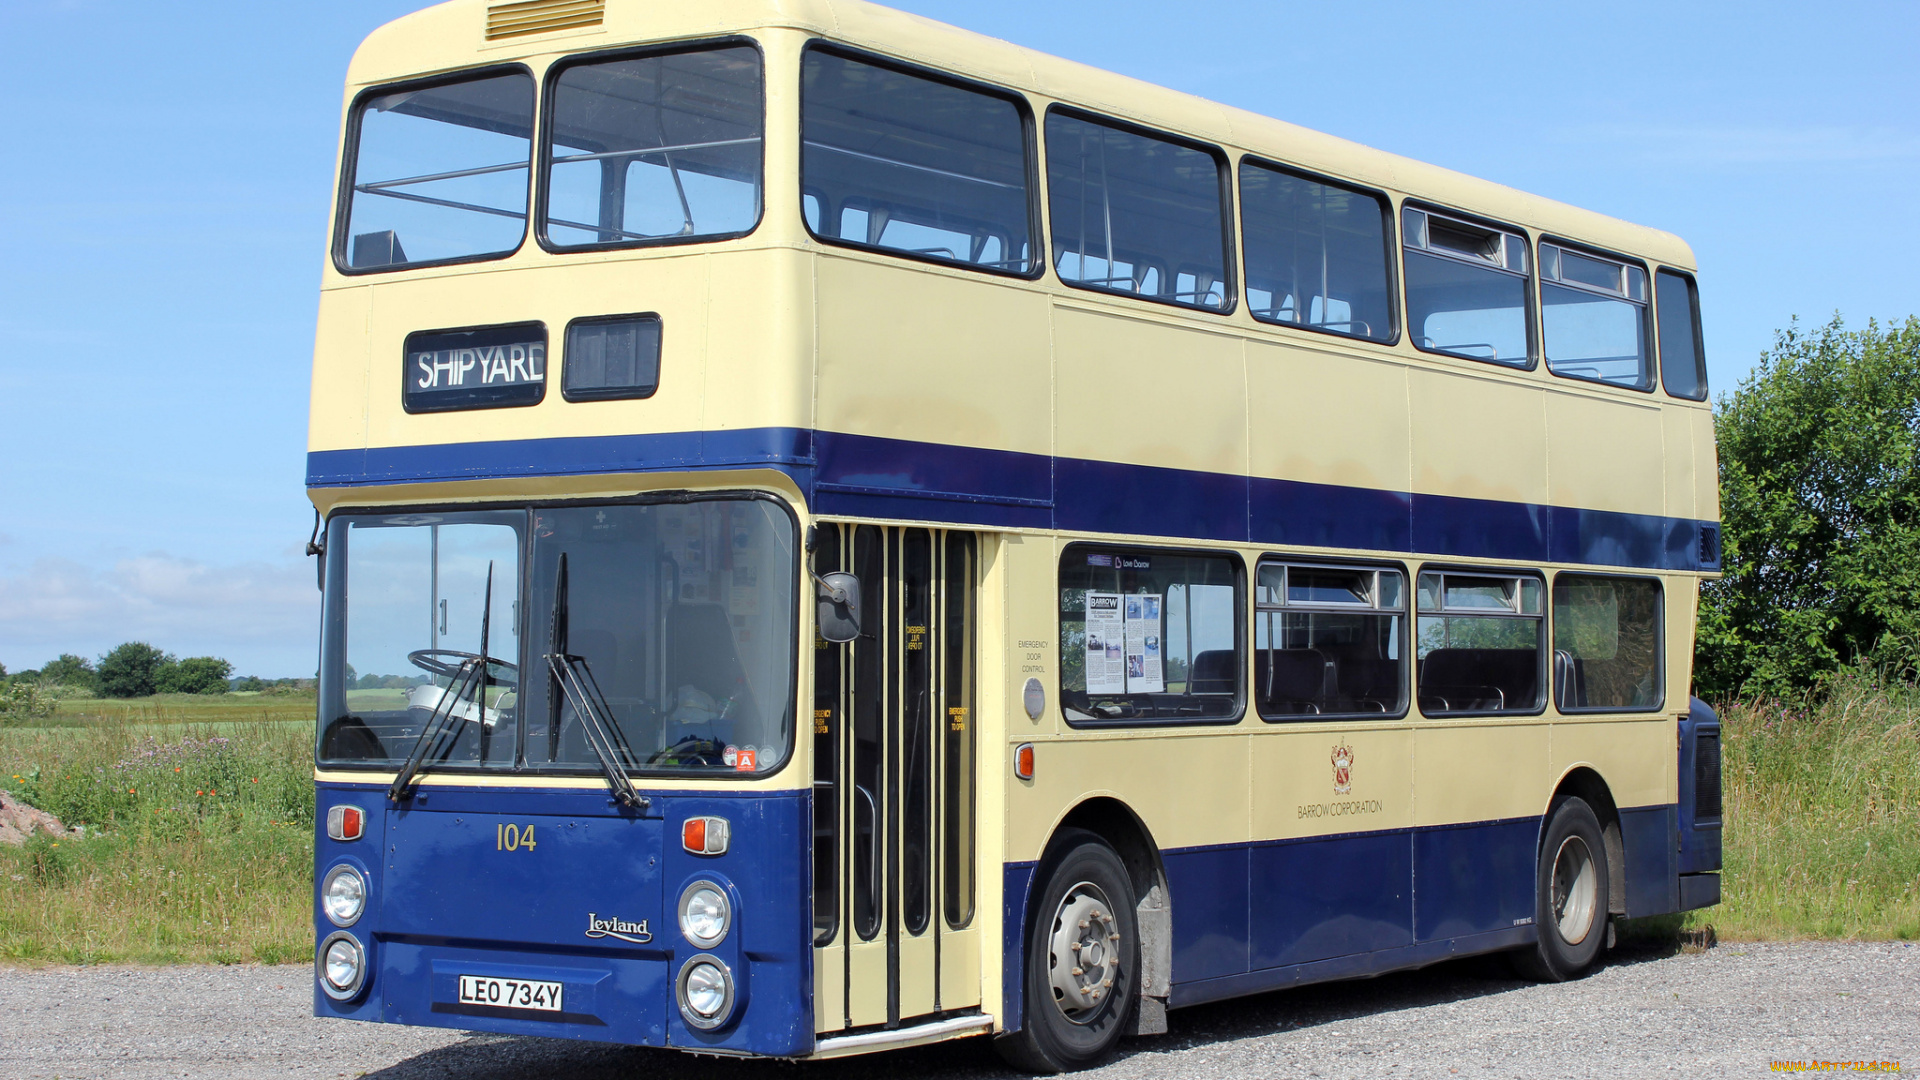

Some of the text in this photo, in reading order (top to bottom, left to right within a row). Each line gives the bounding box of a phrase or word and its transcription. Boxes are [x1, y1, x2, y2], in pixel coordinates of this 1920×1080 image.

[418, 344, 544, 389] SHIPYARD
[1091, 597, 1117, 608] BARROW
[1018, 640, 1048, 648] EMERGENCY
[1026, 652, 1041, 660] DOOR
[1021, 665, 1045, 673] CONTROL
[814, 709, 831, 718] ERGENCY
[741, 755, 751, 765] A
[1298, 799, 1383, 819] BARROW CORPORATION
[497, 823, 536, 852] 104
[585, 912, 652, 943] Leyland
[461, 978, 559, 1007] LEO 734Y
